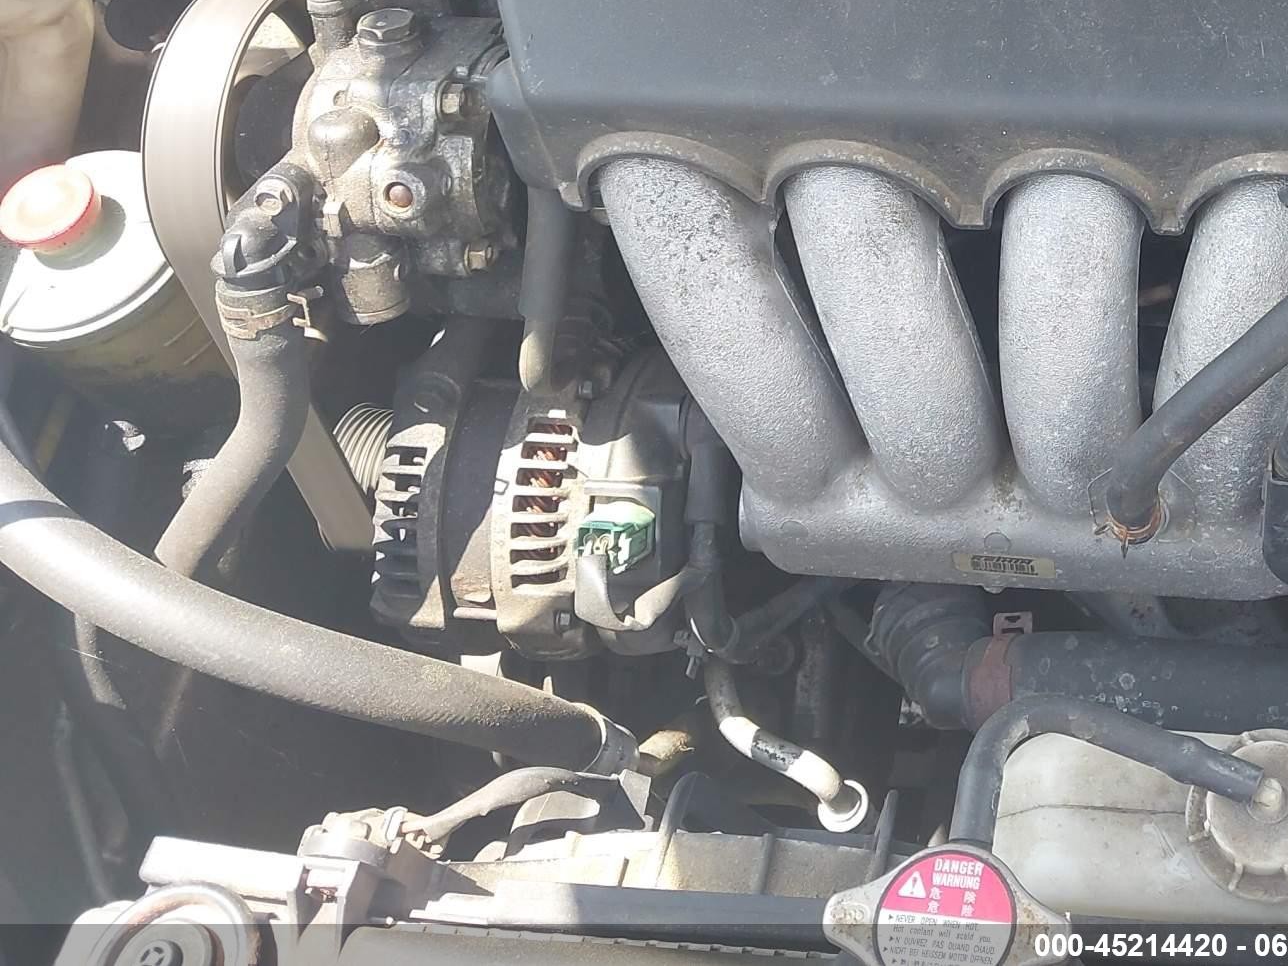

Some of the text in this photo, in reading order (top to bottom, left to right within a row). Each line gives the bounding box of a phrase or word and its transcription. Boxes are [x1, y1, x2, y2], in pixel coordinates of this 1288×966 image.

[934, 858, 984, 877] DANGER
[932, 872, 980, 890] WARNUNG
[895, 914, 916, 923] NEVER
[921, 916, 937, 926] OPEN
[943, 919, 960, 929] WHEN
[893, 923, 905, 933] Hot
[909, 926, 934, 936] coolant
[939, 929, 951, 938] will
[956, 932, 974, 941] scald
[932, 940, 945, 949] PAS
[948, 941, 970, 952] QUAND
[948, 952, 969, 962] MOTOR
